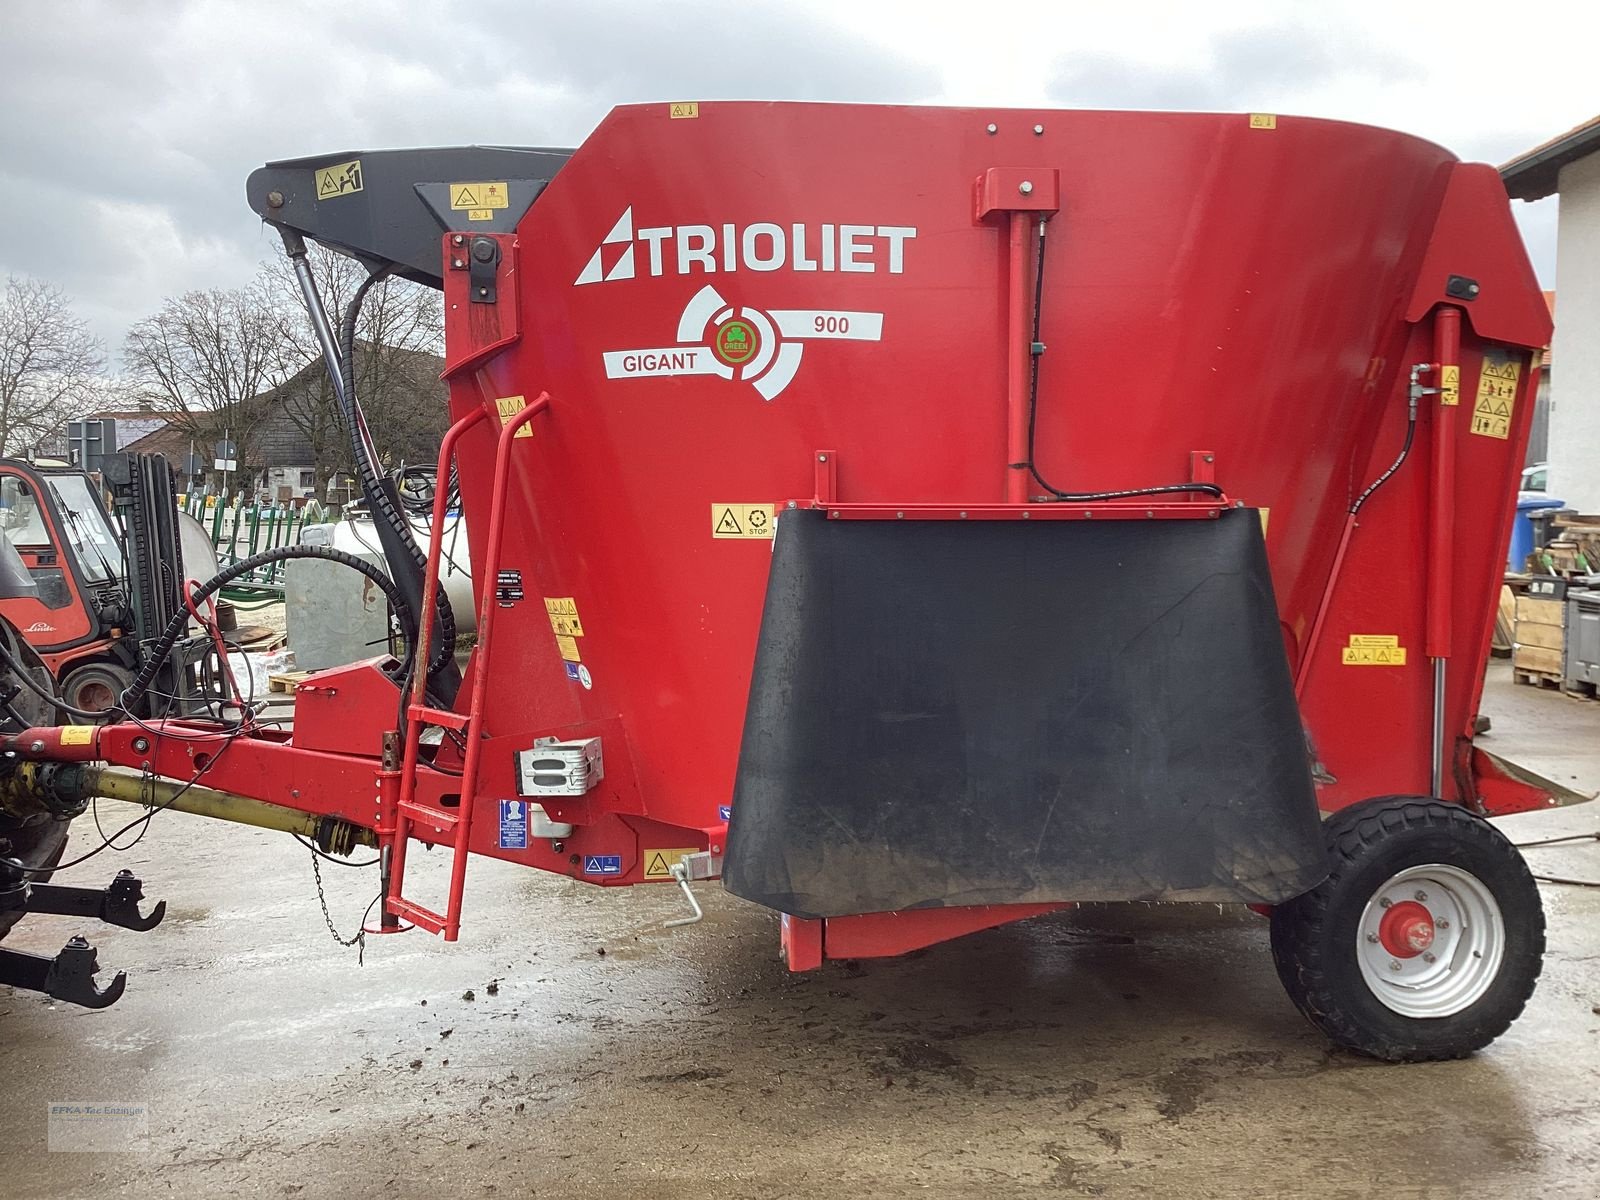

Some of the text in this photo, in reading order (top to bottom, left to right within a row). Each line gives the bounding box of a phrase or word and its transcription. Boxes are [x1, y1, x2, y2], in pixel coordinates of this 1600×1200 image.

[638, 223, 917, 276] TRIOLIET
[814, 316, 849, 333] 900
[725, 342, 748, 350] GREEN
[623, 353, 698, 372] GIGANT
[24, 621, 57, 633] Linde
